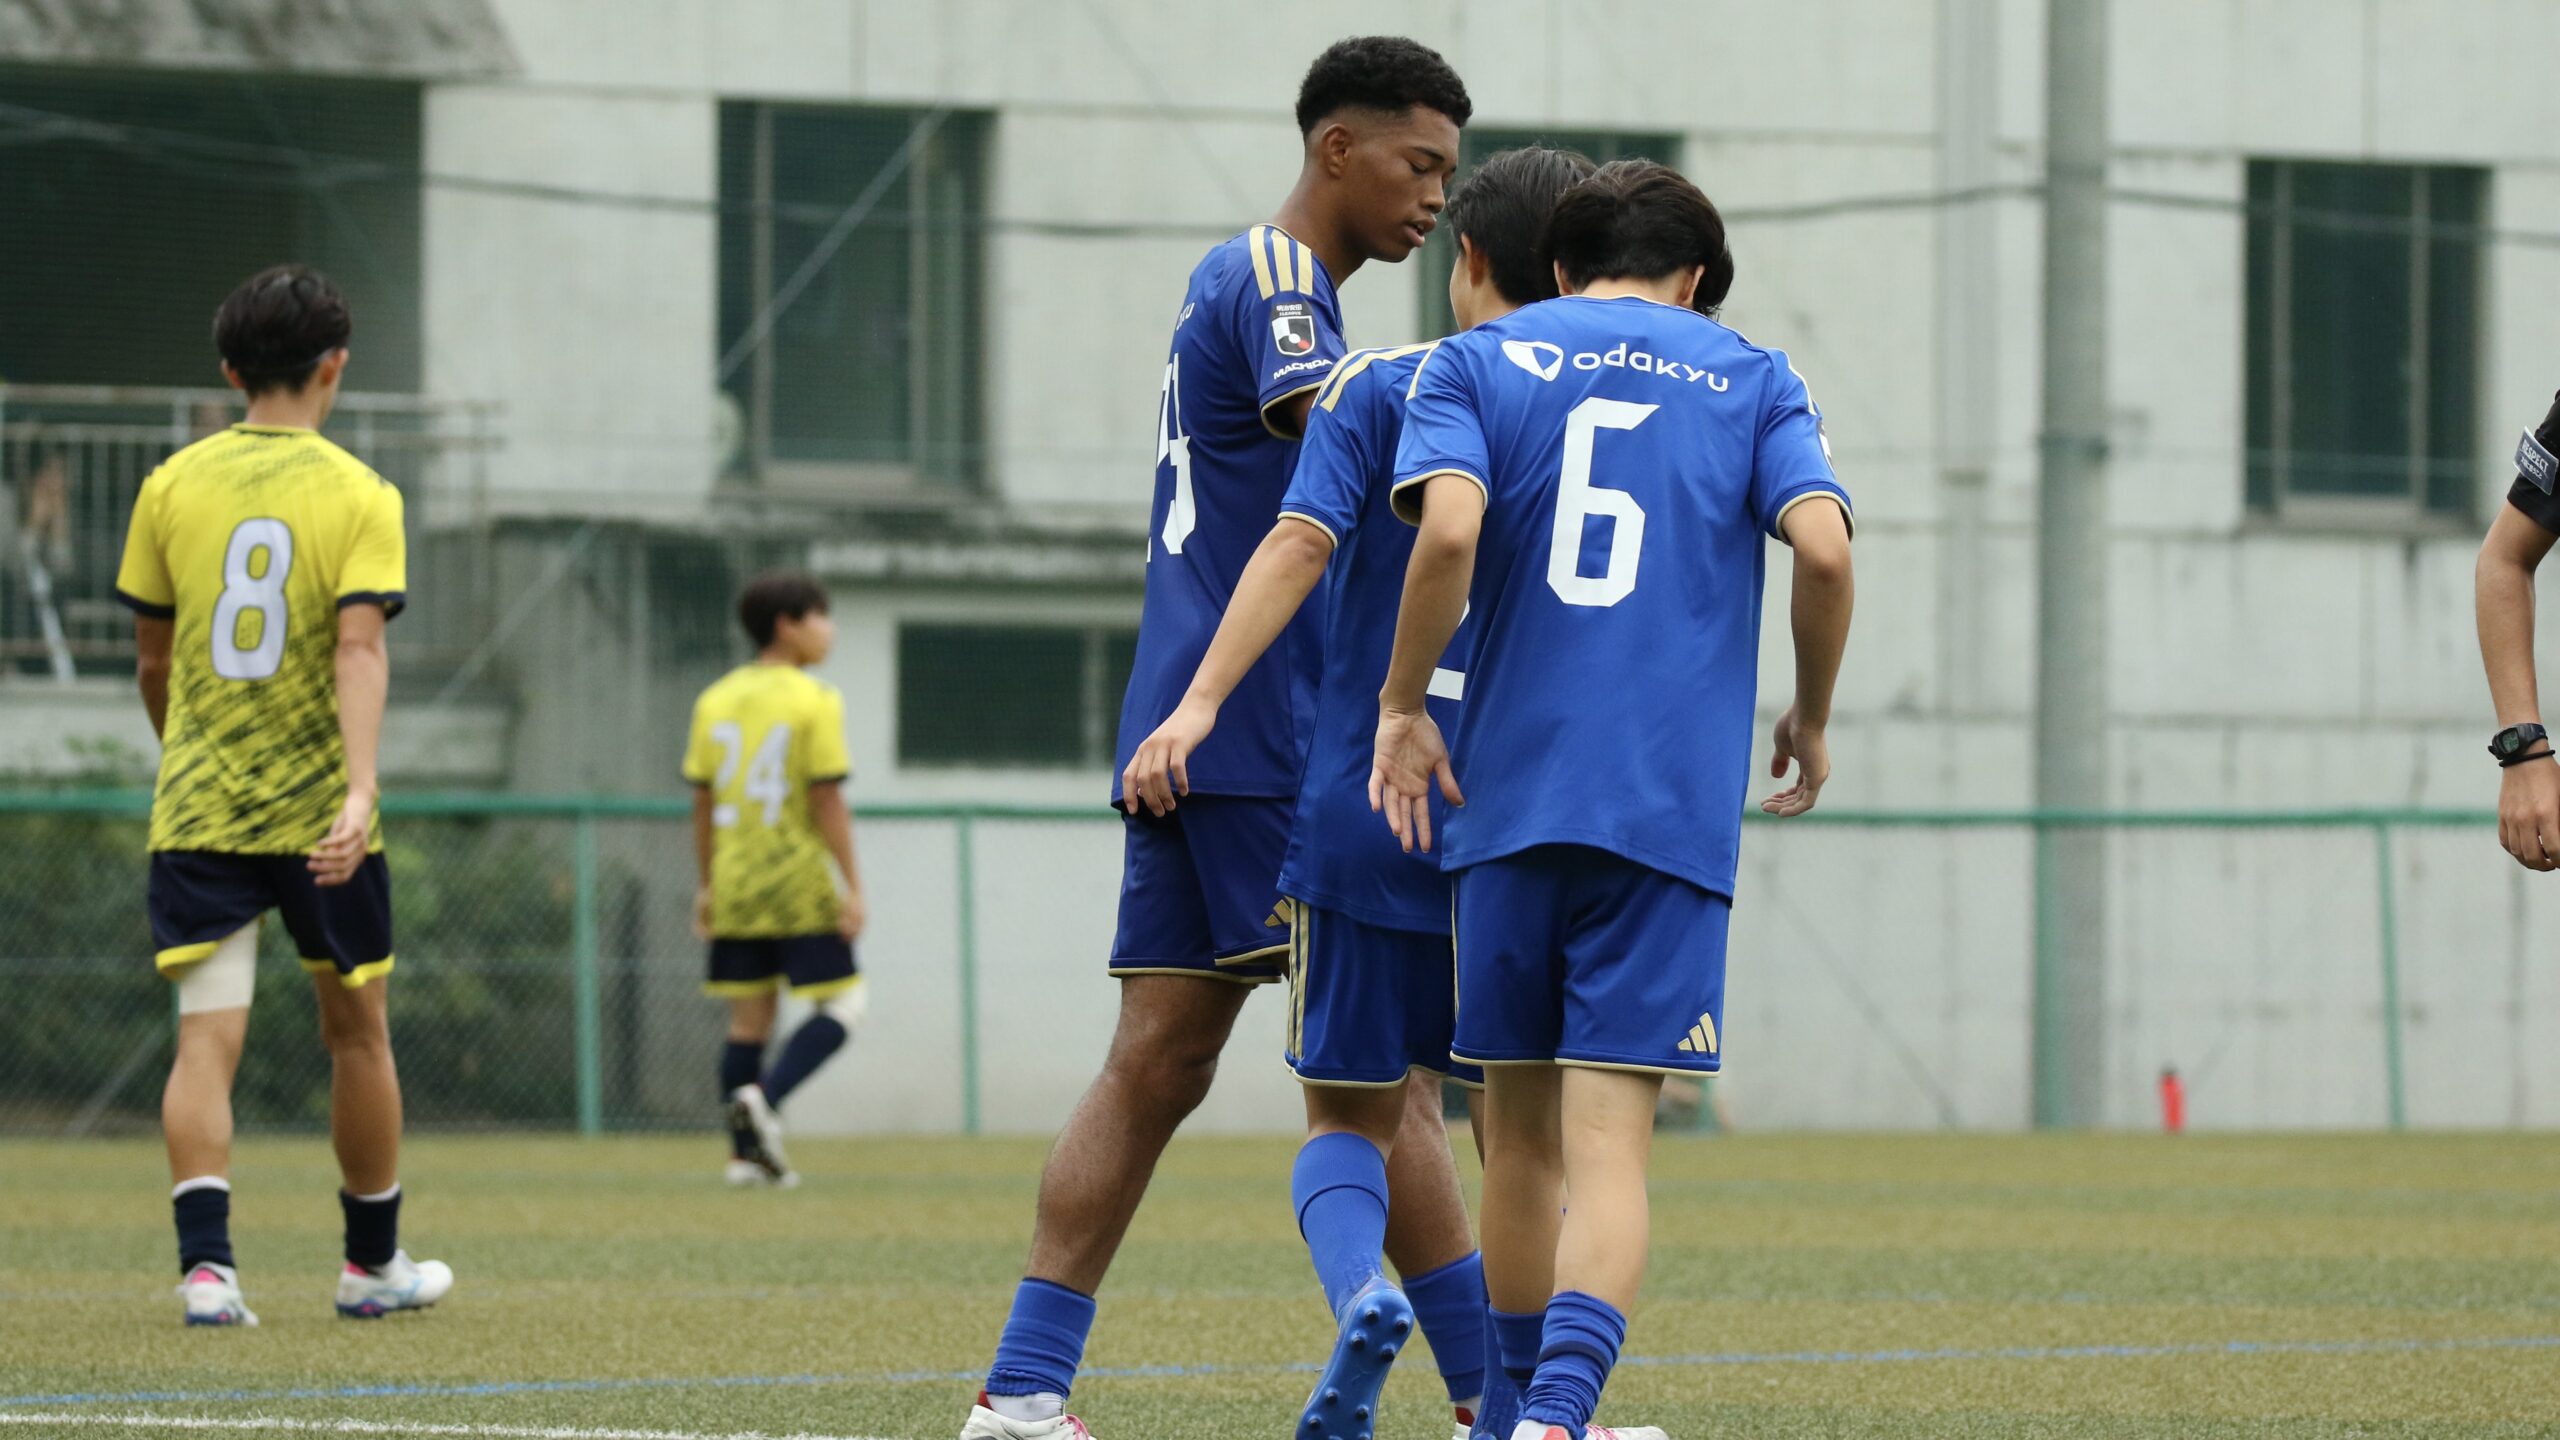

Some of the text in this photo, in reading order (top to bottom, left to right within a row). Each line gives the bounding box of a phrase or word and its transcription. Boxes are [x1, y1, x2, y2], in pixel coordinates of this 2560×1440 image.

[1273, 359, 1333, 380] MACHIDA
[1572, 342, 1729, 393] odakyu
[2521, 439, 2549, 473] RESPECT
[1546, 396, 1661, 608] 6
[210, 516, 295, 681] 8
[710, 721, 792, 828] 24
